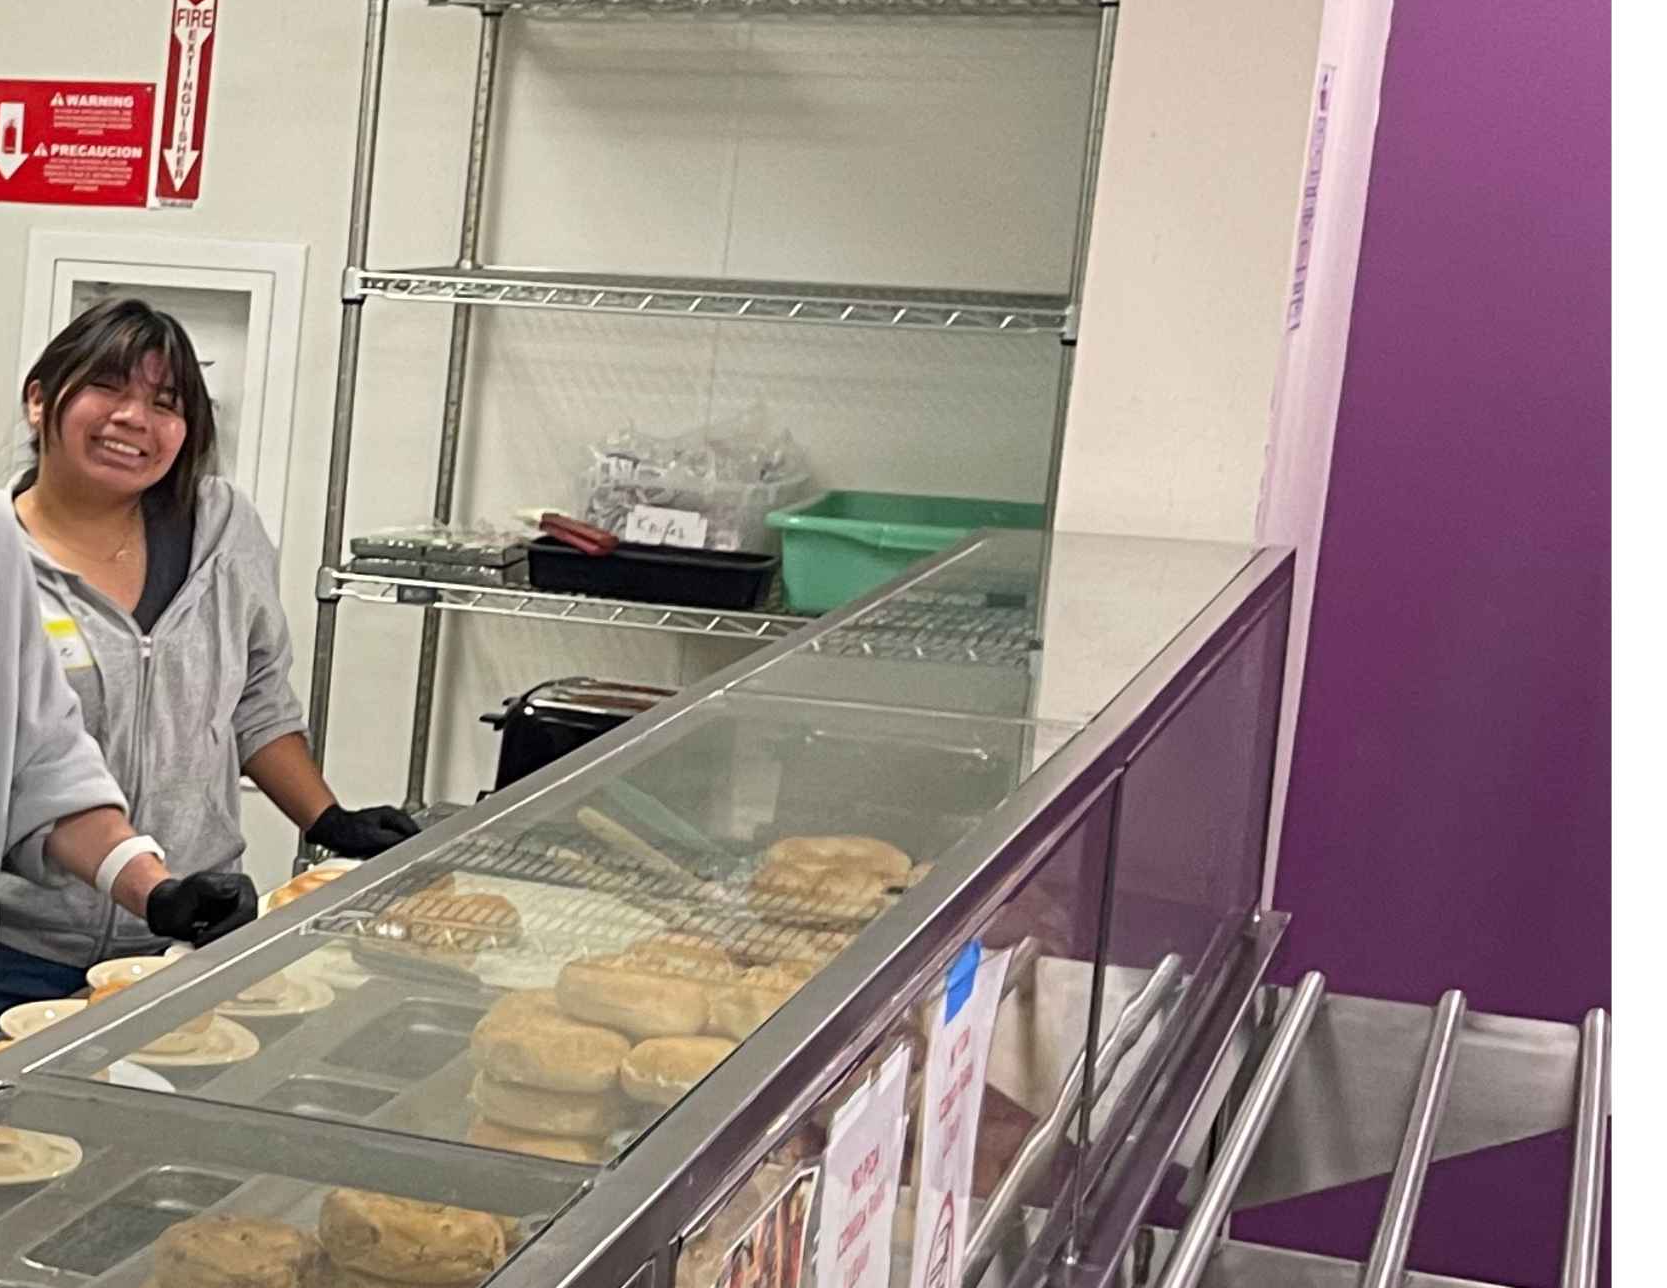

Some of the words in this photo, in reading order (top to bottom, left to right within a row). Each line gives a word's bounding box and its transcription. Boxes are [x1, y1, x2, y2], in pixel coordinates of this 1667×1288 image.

[176, 9, 214, 29] FIRE
[66, 95, 135, 108] WARNING
[174, 29, 197, 180] EXTINGUISHER
[50, 144, 143, 159] PRECAUCION
